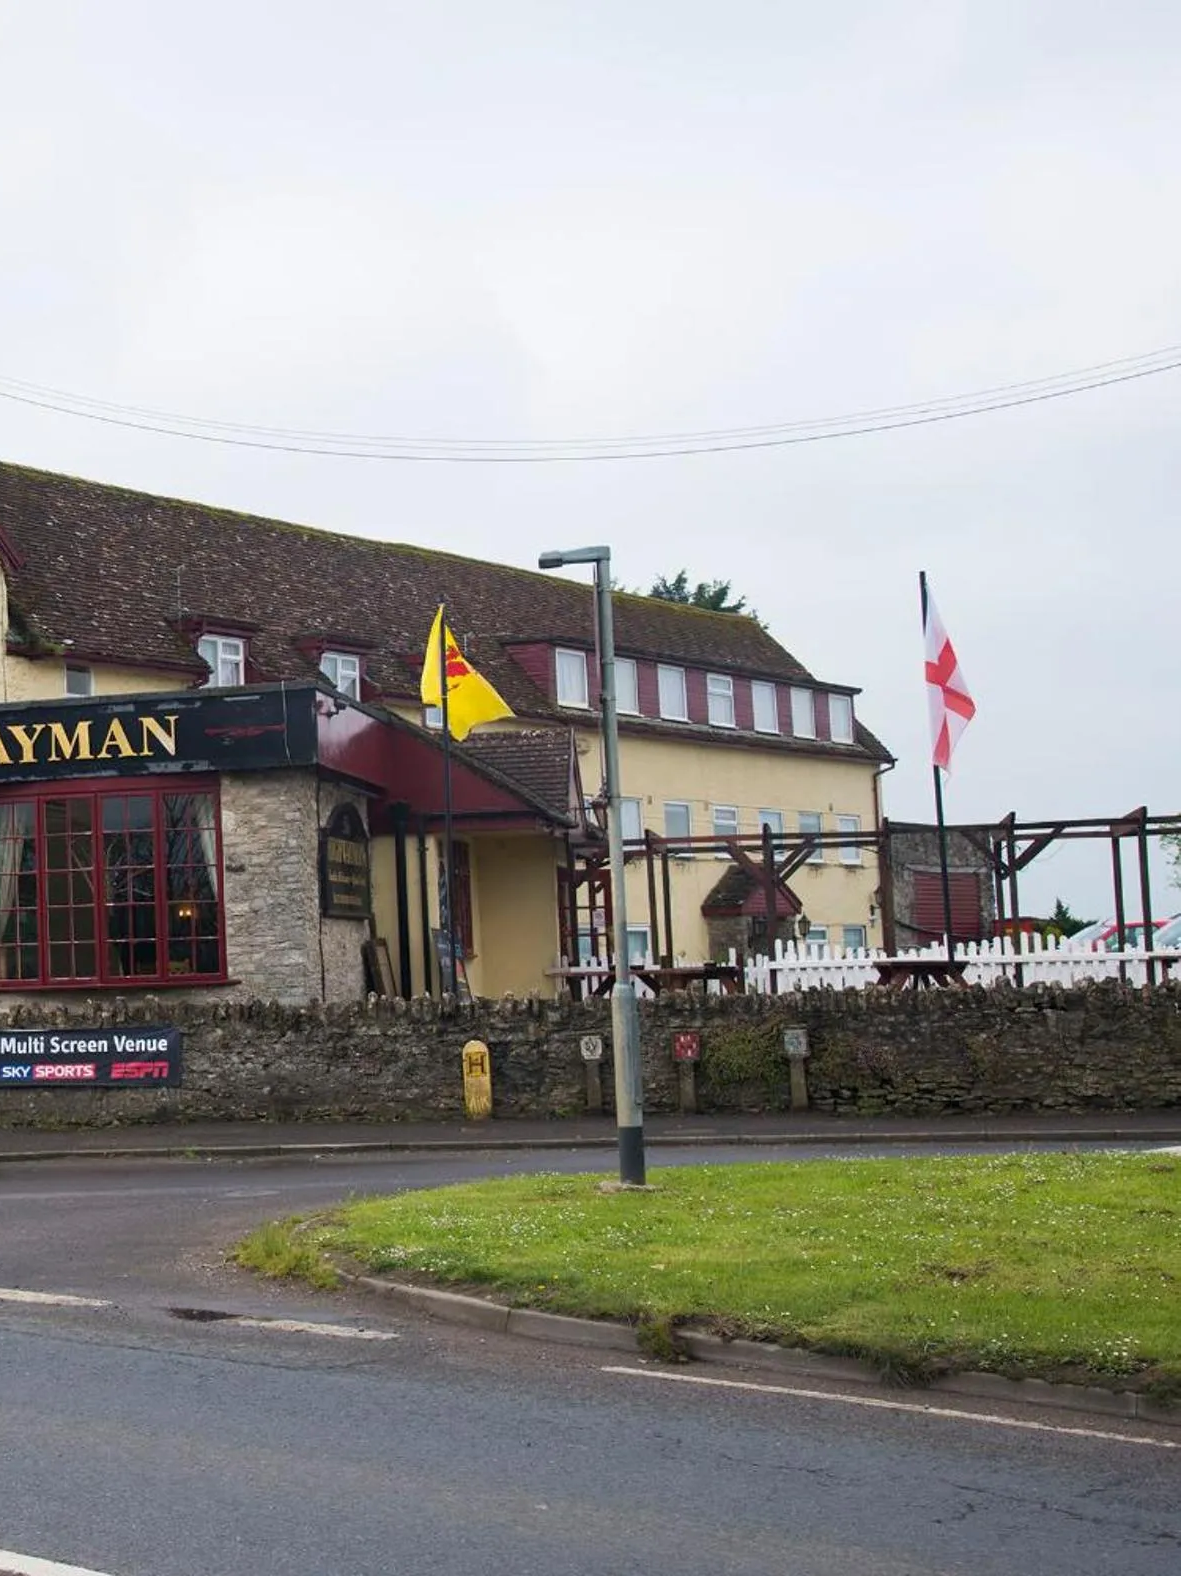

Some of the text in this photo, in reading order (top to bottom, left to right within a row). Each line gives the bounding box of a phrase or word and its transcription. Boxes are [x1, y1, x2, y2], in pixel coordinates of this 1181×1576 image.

[0, 1035, 169, 1055] Multi Screen Venue
[1, 1062, 169, 1079] SKY SPORTS ESPN
[465, 1052, 487, 1077] H
